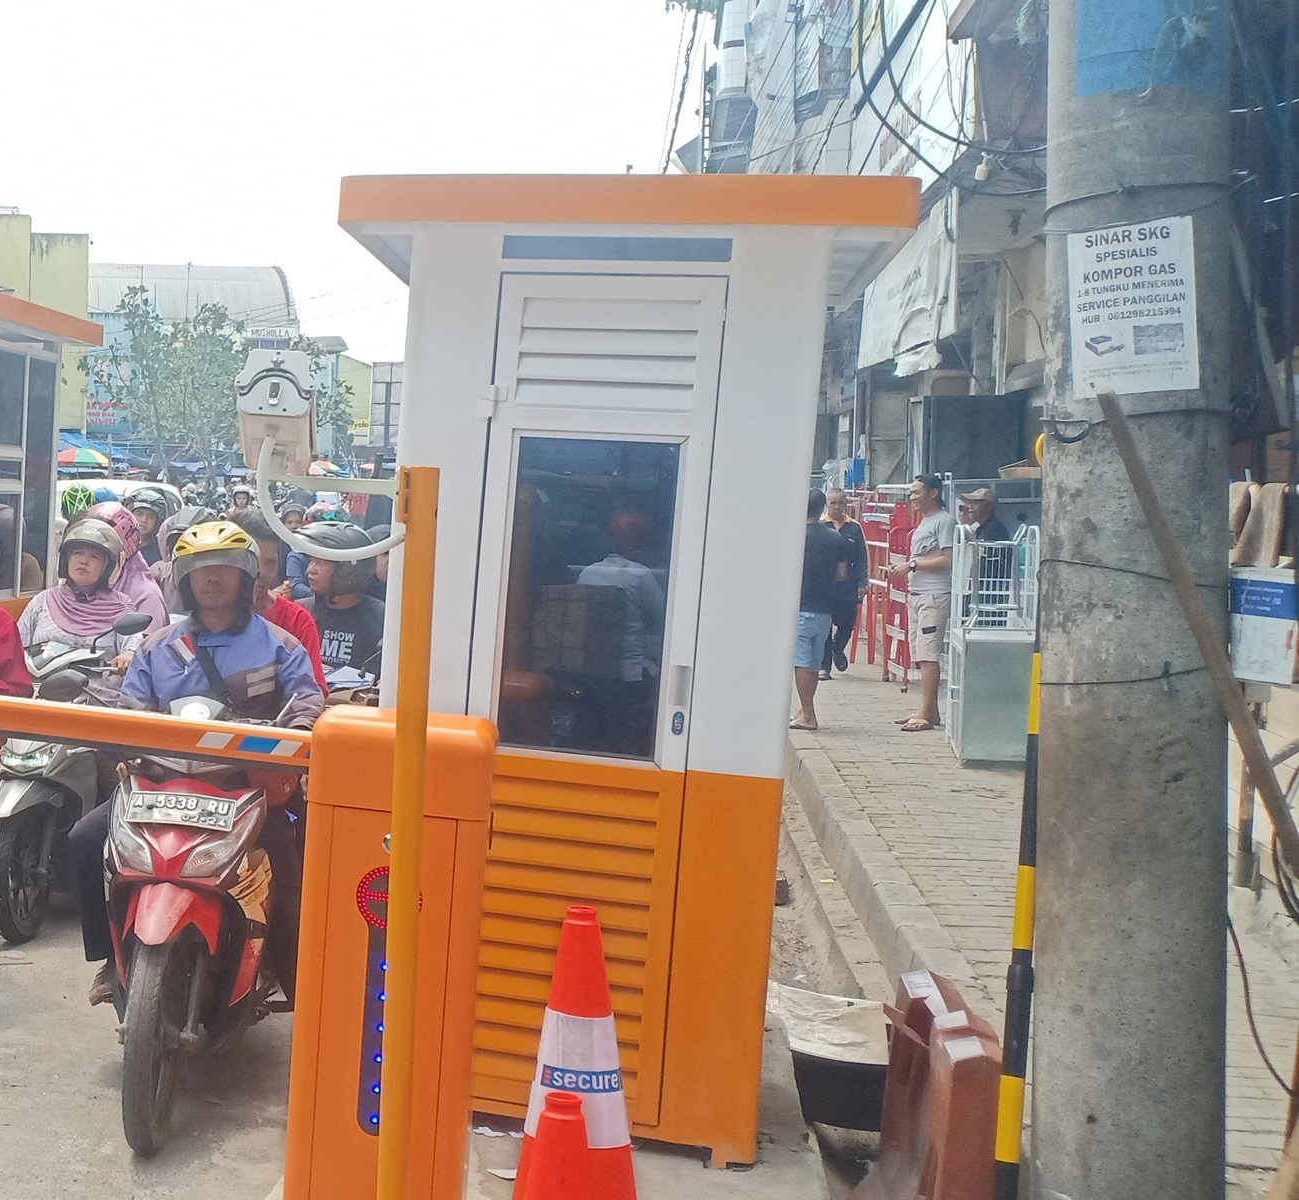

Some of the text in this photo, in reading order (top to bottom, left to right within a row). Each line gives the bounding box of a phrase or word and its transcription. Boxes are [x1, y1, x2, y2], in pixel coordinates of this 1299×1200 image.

[1084, 226, 1171, 248] SINAR SKG
[1095, 247, 1158, 263] SPESIALIS
[1083, 263, 1177, 284] KOMPOR GAS
[1091, 283, 1129, 295] TUNGKU
[1131, 278, 1185, 290] MENERIMA
[1077, 292, 1186, 313] SERVICE PANGGILAN
[251, 328, 290, 338] MUSHOLLA
[323, 629, 356, 642] SHOW
[320, 638, 354, 660] ME
[133, 794, 231, 816] A 5338 RU
[552, 1071, 619, 1089] secure
